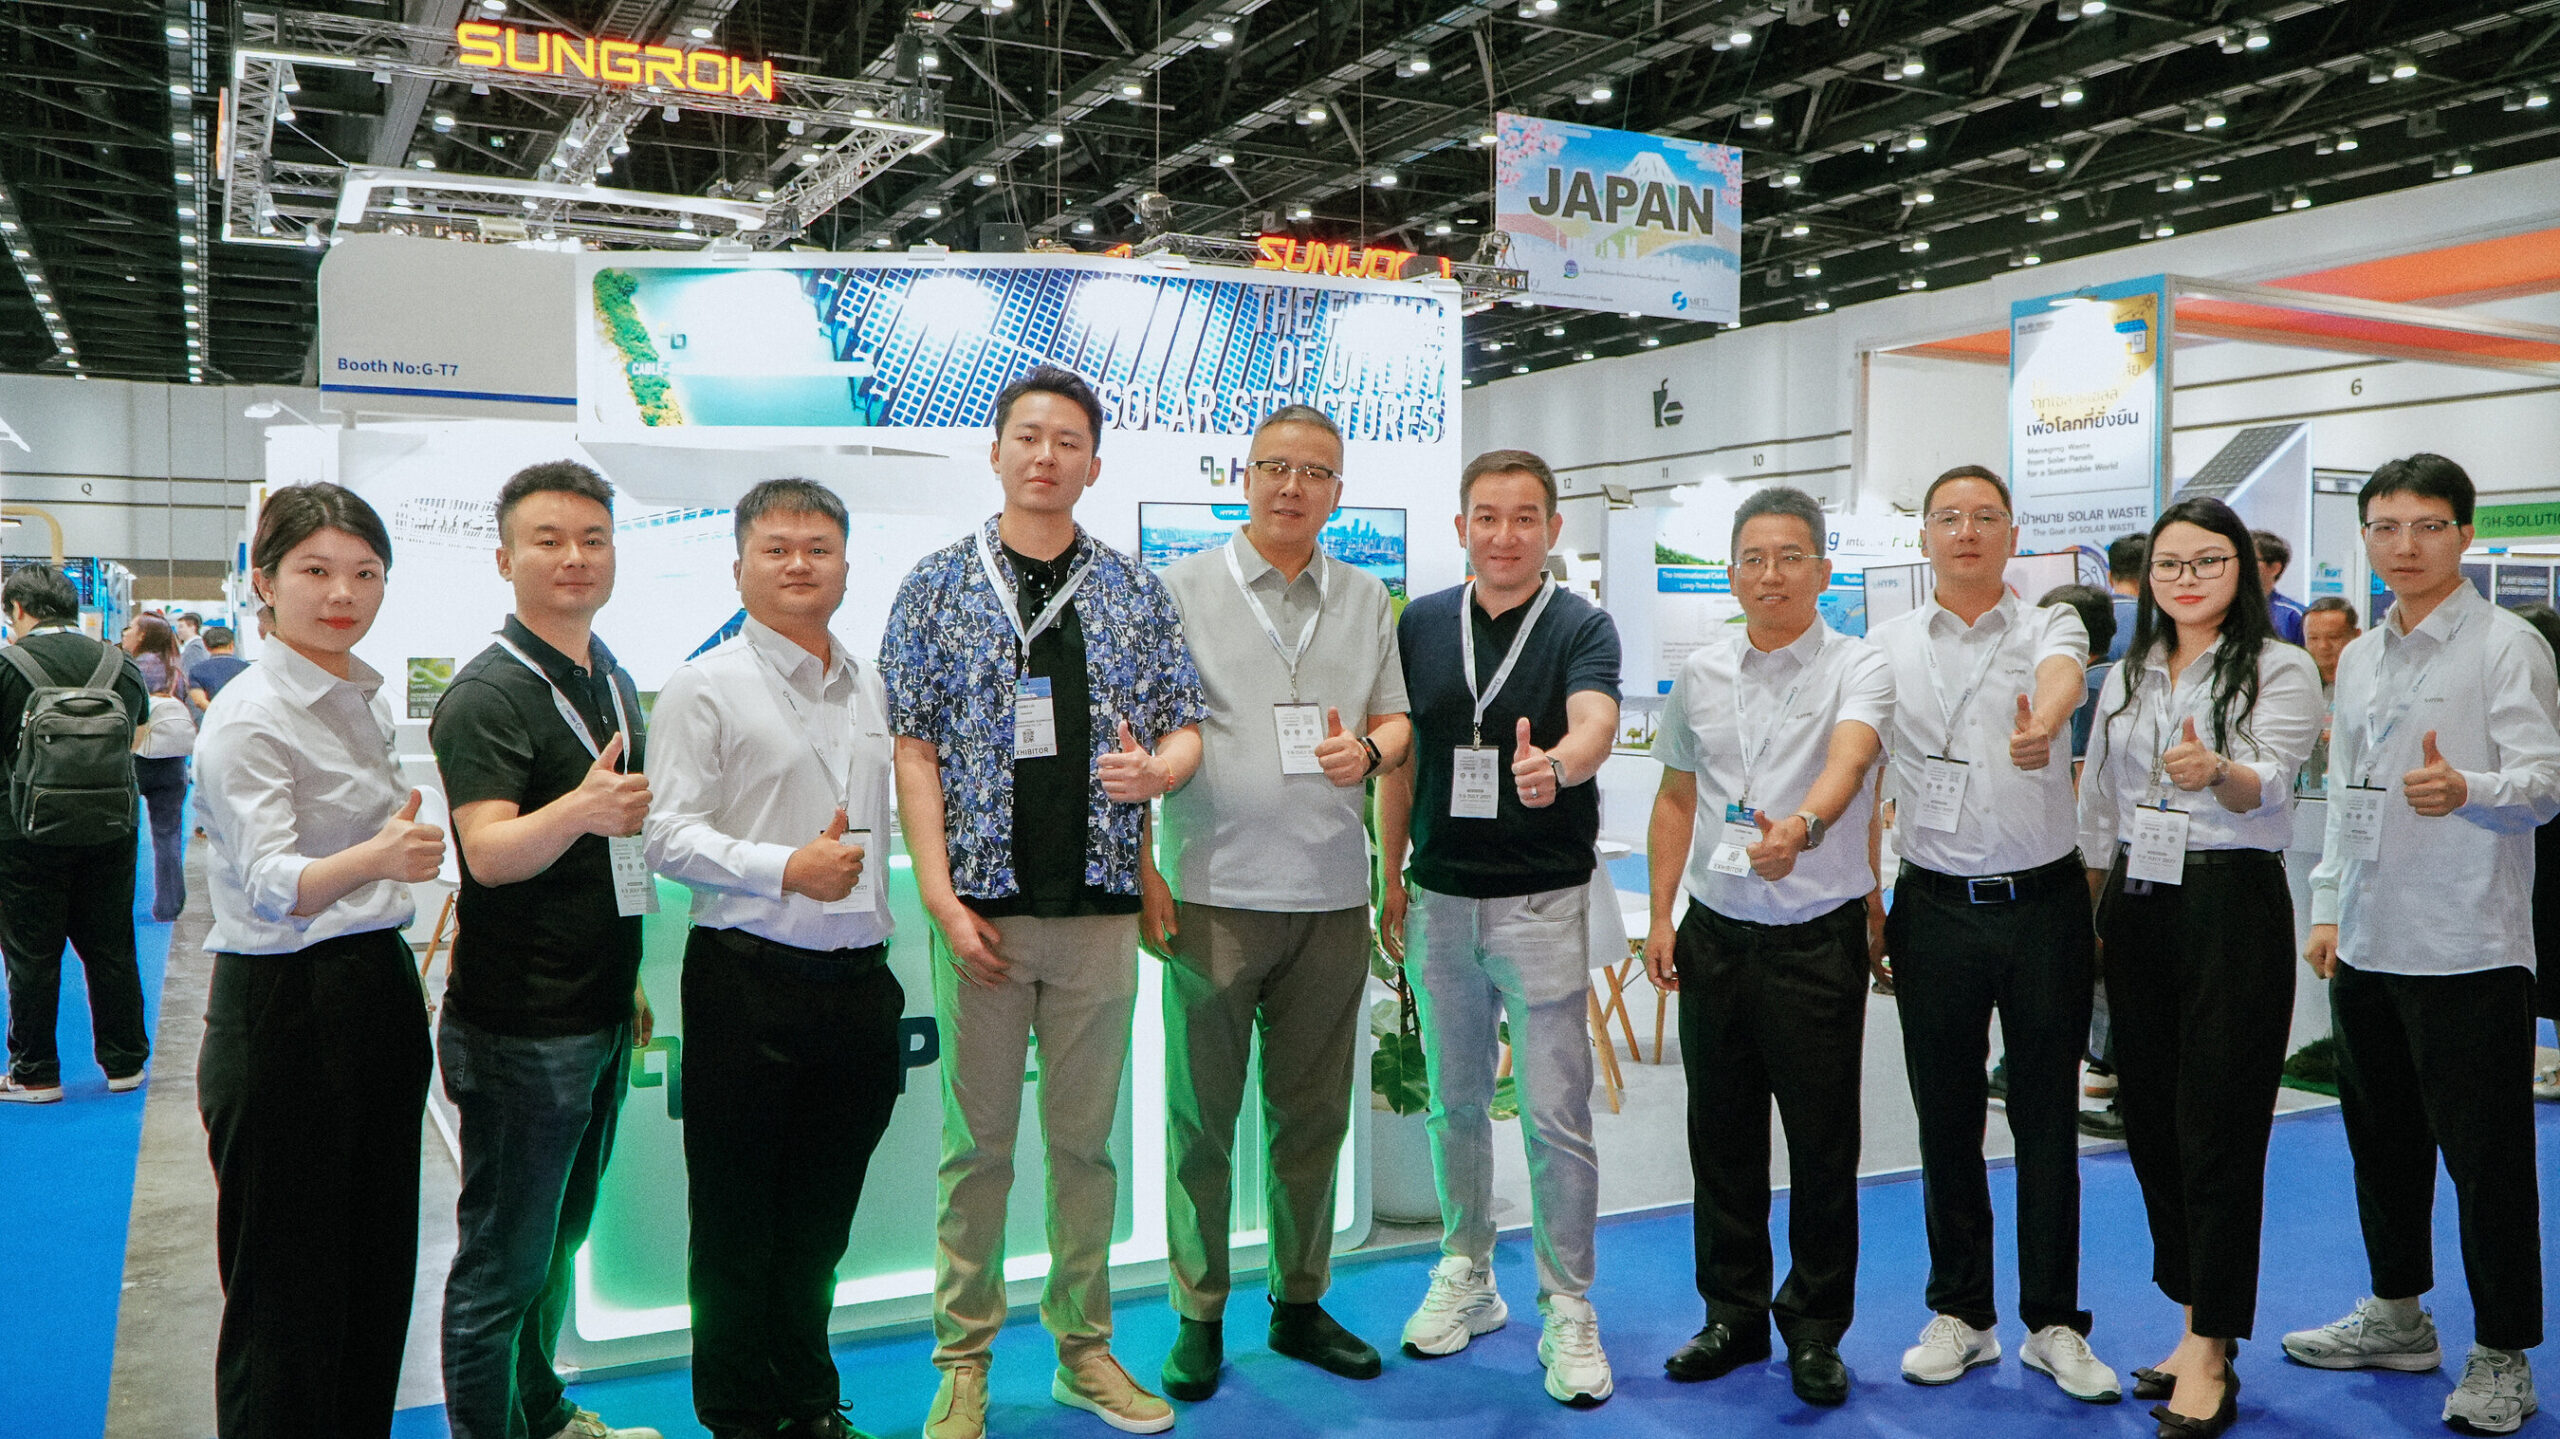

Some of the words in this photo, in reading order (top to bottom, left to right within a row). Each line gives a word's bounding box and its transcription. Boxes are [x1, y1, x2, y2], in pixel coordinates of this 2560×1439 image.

[457, 22, 772, 101] SUNGROW
[1528, 167, 1714, 236] JAPAN
[1254, 236, 1450, 282] SUNWO
[1253, 284, 1318, 337] THE
[337, 357, 388, 373] Booth
[392, 361, 459, 377] No:G-T7
[1273, 338, 1318, 389] OF
[2351, 378, 2363, 396] 6
[1100, 380, 1217, 435] SOLAR
[1227, 388, 1444, 444] STCTURES
[2026, 405, 2139, 437] เพื่อโลกที่ยั่งยืน
[2068, 442, 2091, 451] Waste
[1753, 453, 1764, 467] 10
[2047, 456, 2066, 465] Solar
[1661, 467, 1669, 478] 11
[2047, 465, 2092, 477] Sustainable
[2094, 461, 2119, 472] World
[81, 482, 93, 496] Q
[1563, 478, 1573, 489] 12
[2067, 509, 2104, 522] SOLAR
[2107, 506, 2148, 520] WASTE
[2032, 528, 2046, 536] The
[2049, 527, 2066, 536] Goal
[2068, 525, 2077, 535] of
[2079, 524, 2106, 534] SOLAR
[2108, 522, 2137, 533] WASTE
[1015, 746, 1050, 757] XHIBITOR
